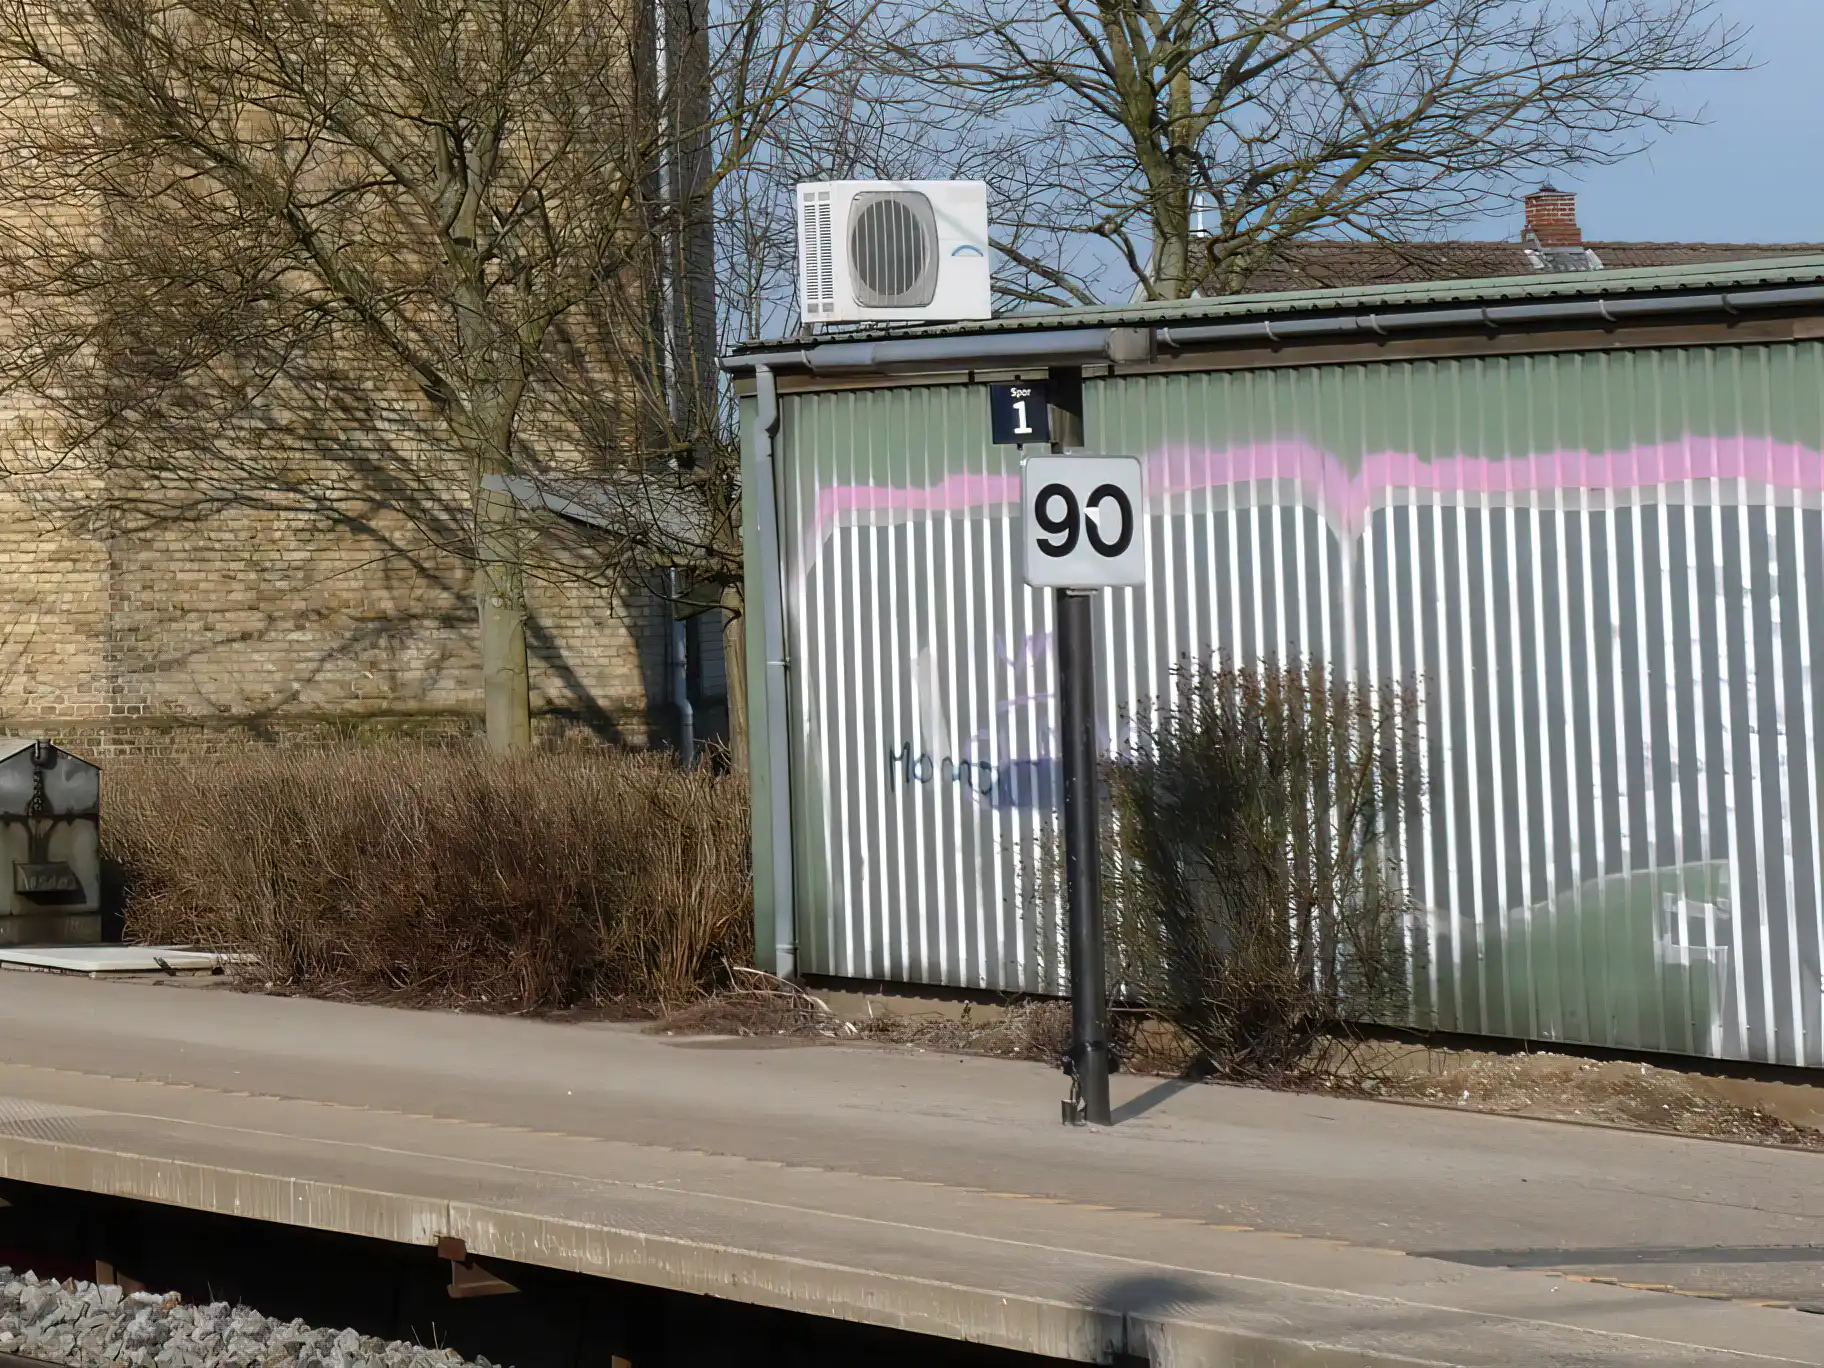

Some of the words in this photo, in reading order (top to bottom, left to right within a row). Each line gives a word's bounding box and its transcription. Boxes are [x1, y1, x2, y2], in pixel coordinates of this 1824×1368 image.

[1010, 387, 1031, 398] Spor
[1012, 400, 1033, 434] 1
[1034, 482, 1134, 558] 90
